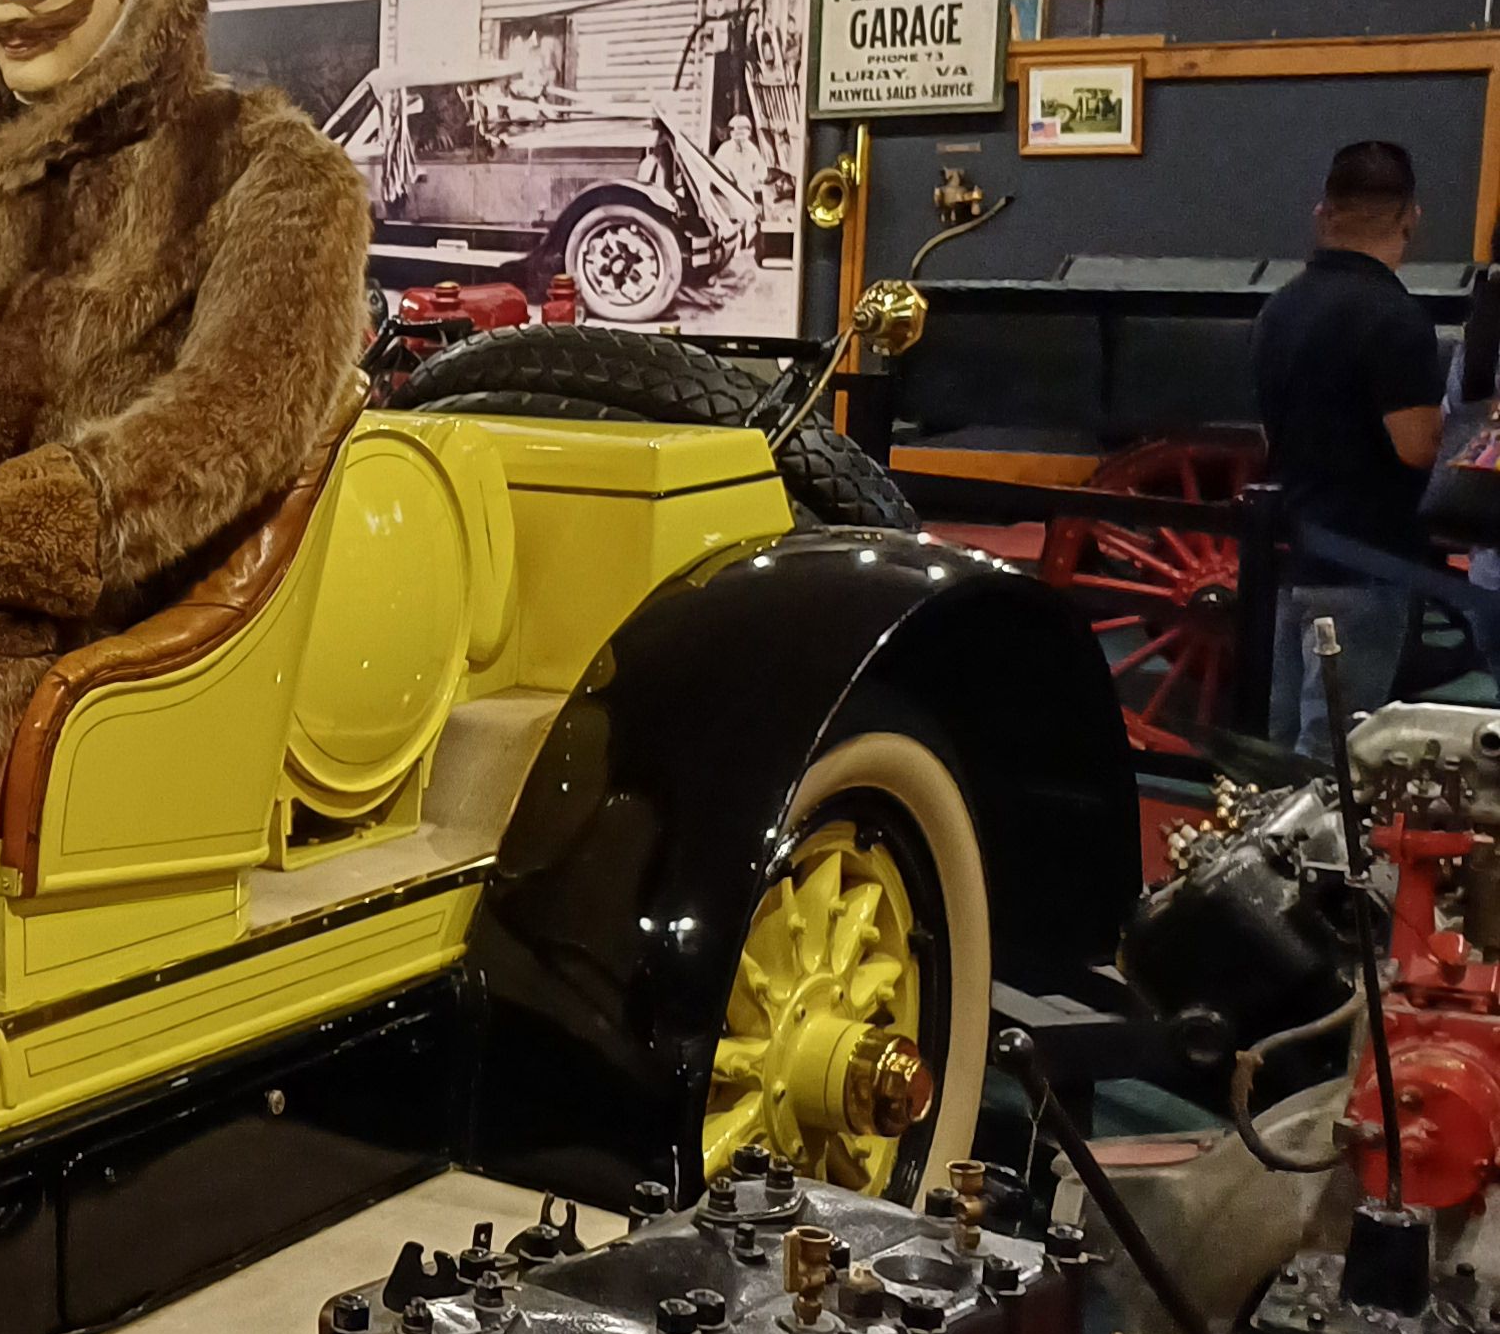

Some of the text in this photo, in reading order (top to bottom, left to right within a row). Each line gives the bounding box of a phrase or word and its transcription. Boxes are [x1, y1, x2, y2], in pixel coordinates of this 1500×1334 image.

[850, 2, 963, 50] GARAGE
[867, 54, 919, 64] PHONE
[829, 87, 882, 102] MAXWELL
[886, 85, 917, 100] SALES
[930, 83, 974, 98] SERVICE
